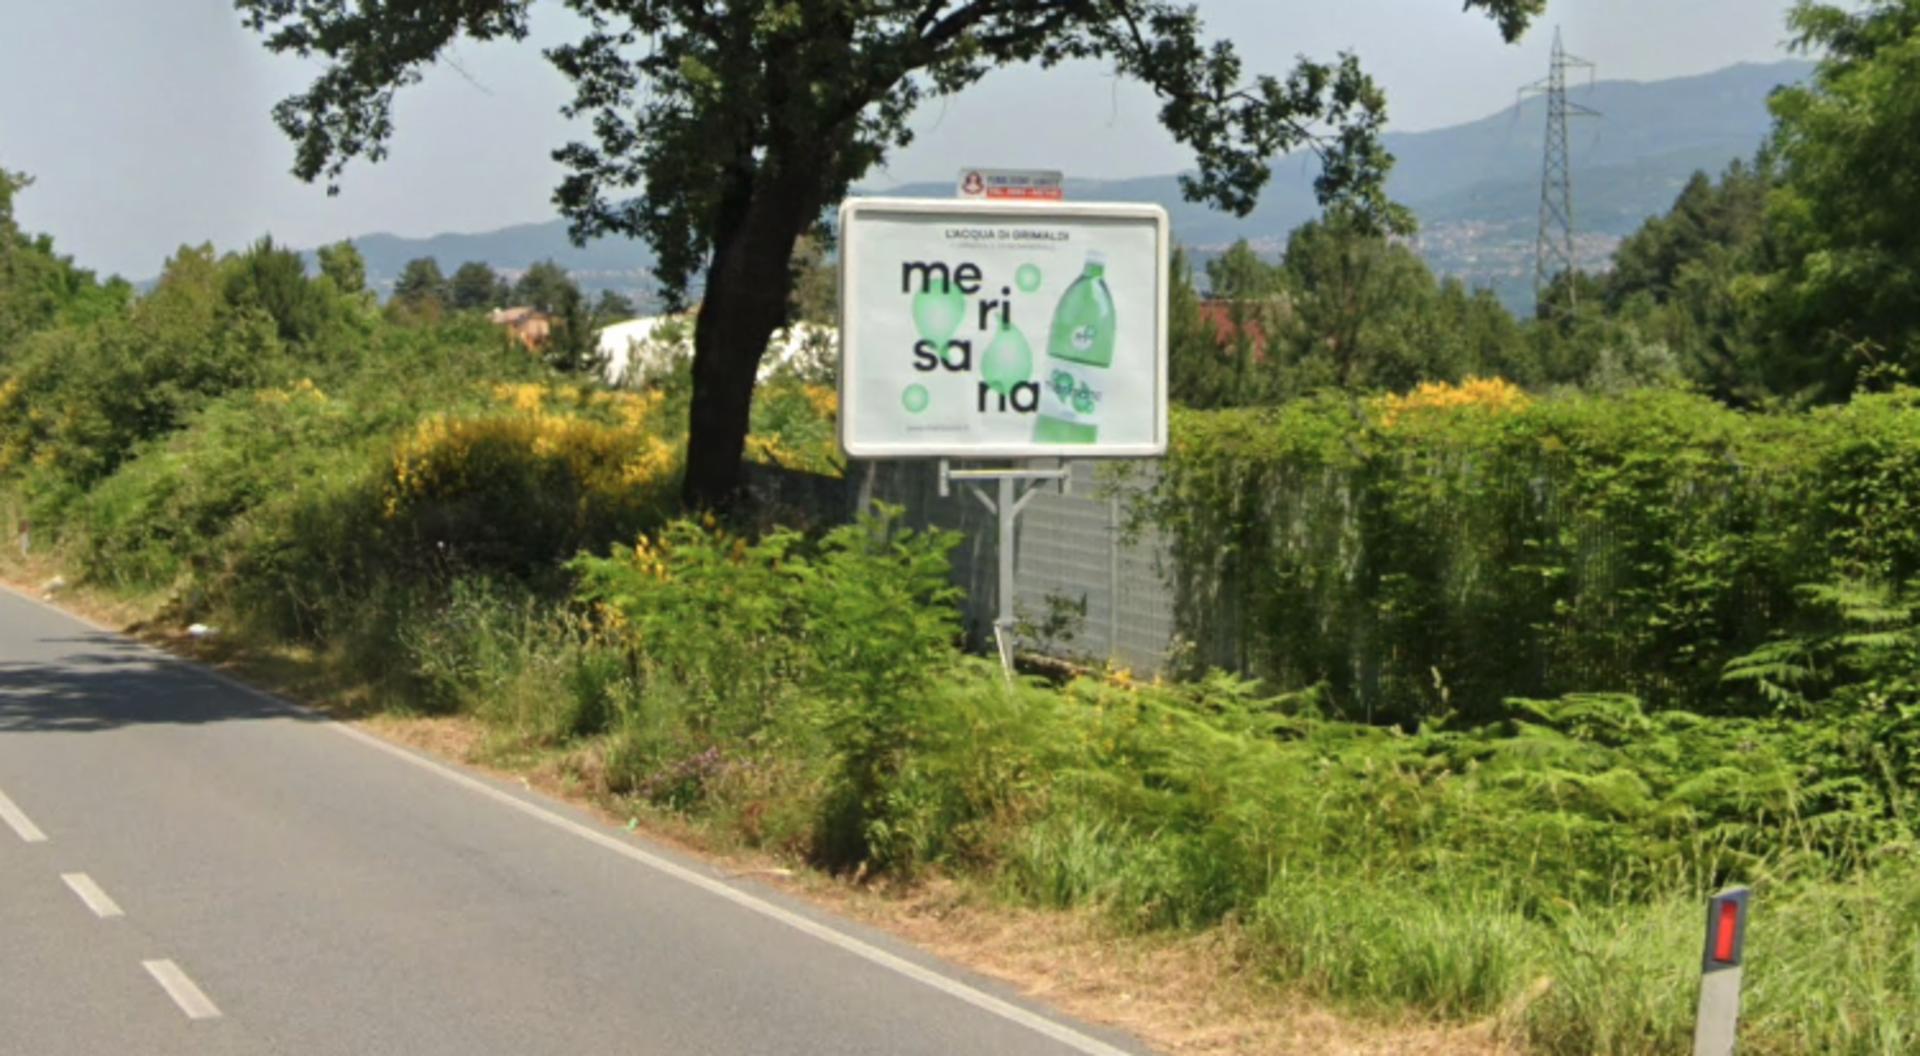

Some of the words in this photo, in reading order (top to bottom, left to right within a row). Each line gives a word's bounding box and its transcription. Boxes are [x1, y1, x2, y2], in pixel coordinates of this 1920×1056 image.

[945, 229, 995, 240] L'ACQUA
[997, 230, 1010, 240] DI
[1012, 229, 1070, 241] GRIMALDI
[902, 261, 982, 294] me
[978, 286, 1010, 330] ri
[913, 339, 972, 372] sa
[977, 380, 1040, 413] na
